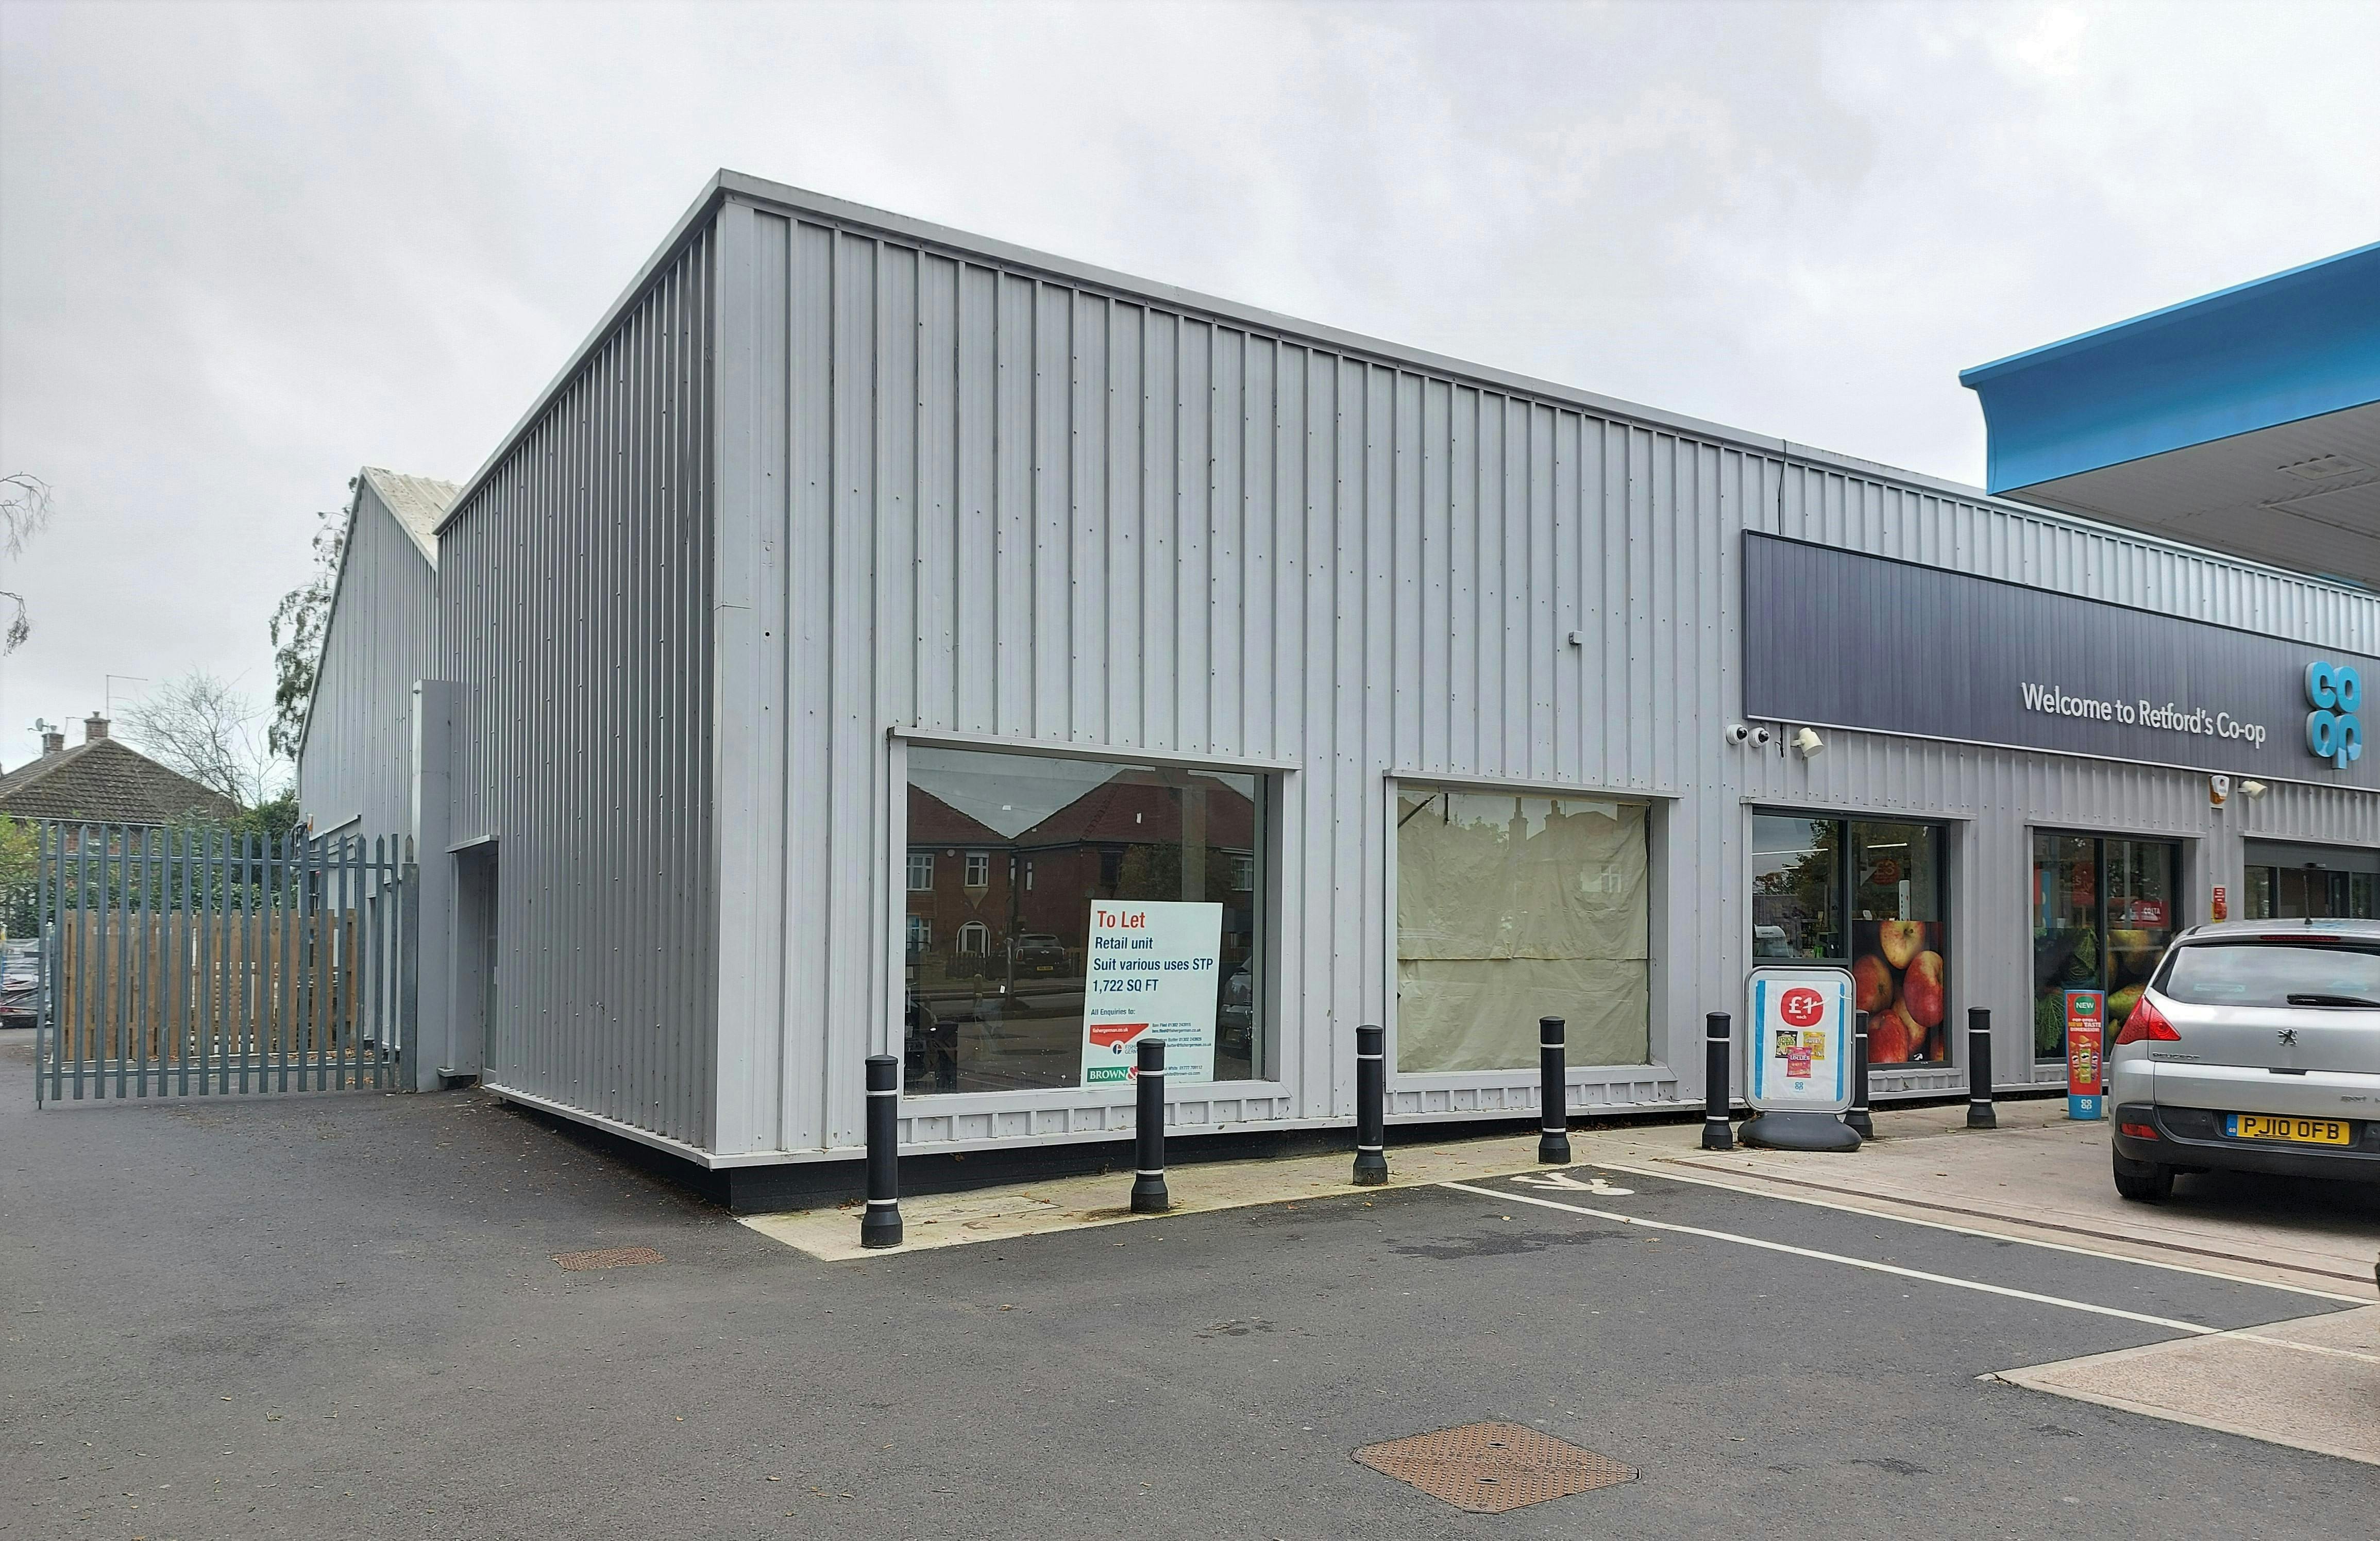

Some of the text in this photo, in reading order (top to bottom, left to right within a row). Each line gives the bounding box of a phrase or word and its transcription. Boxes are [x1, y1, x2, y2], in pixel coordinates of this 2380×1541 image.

[2021, 681, 2266, 749] Welcome to Retford's Co-op
[1097, 910, 1145, 928] To Let
[1095, 936, 1153, 949] Retail unit
[1093, 958, 1213, 970] Suit various uses STP
[1092, 979, 1159, 994] 1,722 SQ FT
[1788, 996, 1812, 1014] £1
[2153, 1052, 2200, 1060] PEUGEOT
[2244, 1117, 2290, 1135] PJ10
[2298, 1121, 2339, 1140] OFB
